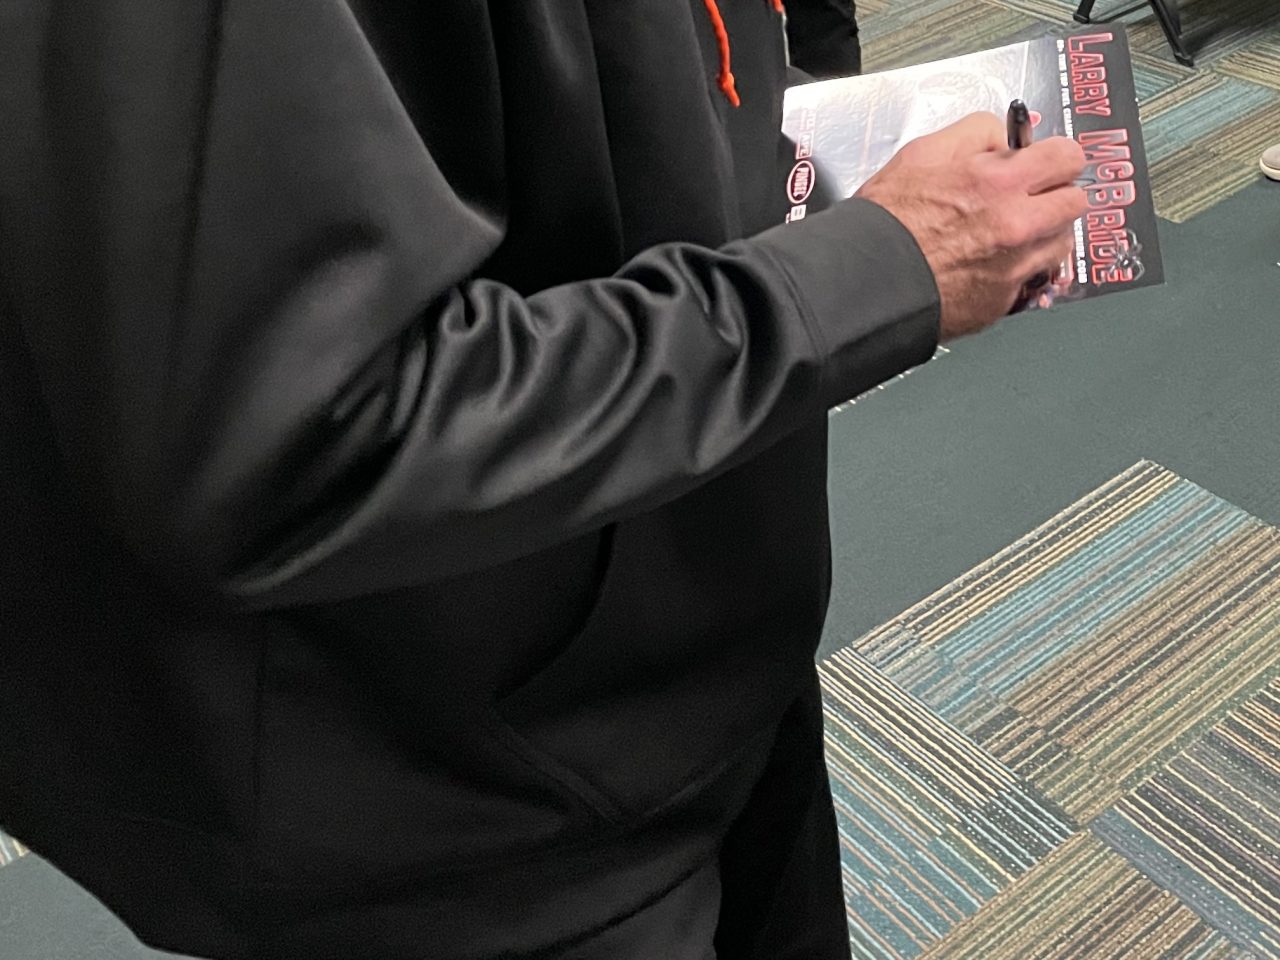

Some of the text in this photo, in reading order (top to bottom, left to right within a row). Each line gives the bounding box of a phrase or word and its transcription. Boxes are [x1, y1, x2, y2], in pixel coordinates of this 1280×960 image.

[1060, 71, 1069, 87] TOP
[1068, 32, 1113, 116] LARRY
[1061, 87, 1071, 107] FUEL
